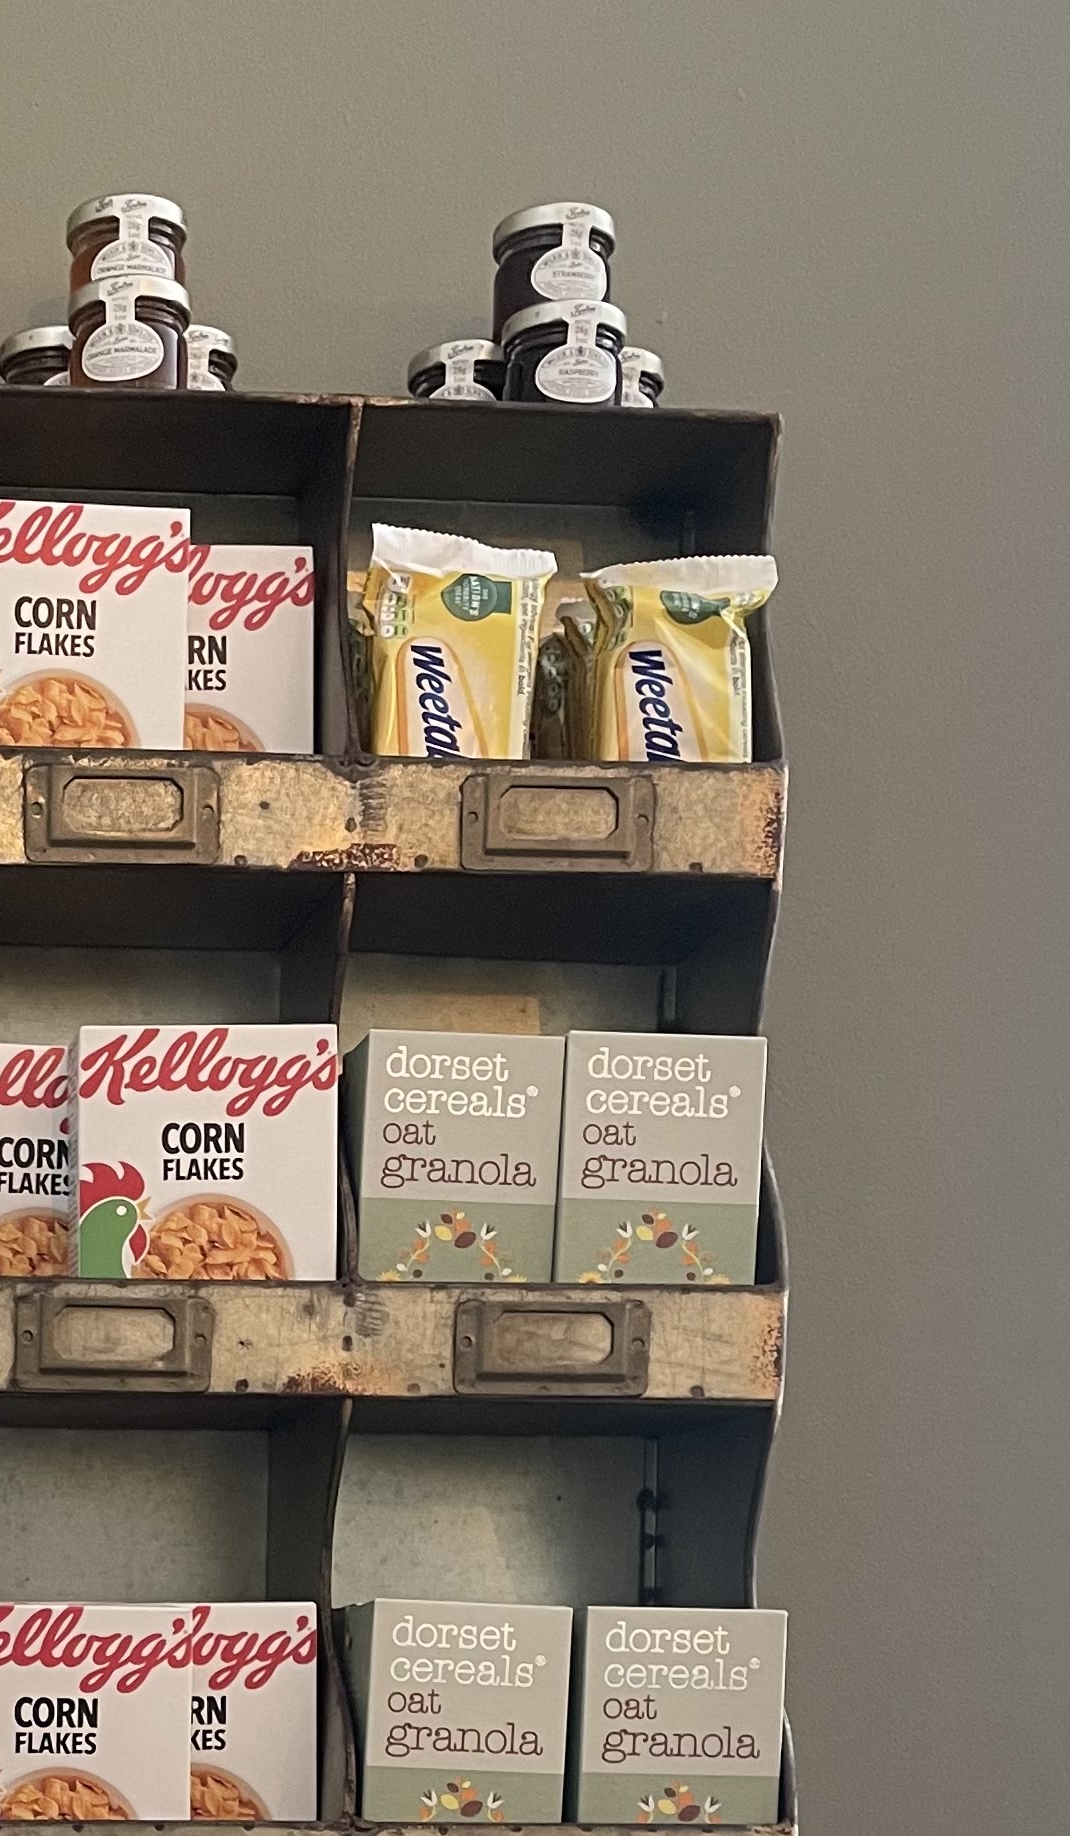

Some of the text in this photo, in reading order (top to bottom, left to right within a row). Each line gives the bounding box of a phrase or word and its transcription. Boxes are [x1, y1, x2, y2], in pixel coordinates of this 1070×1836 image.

[14, 596, 97, 631] CORN
[14, 632, 95, 658] FLAKES
[187, 635, 227, 665] RN
[186, 669, 227, 691] KES
[410, 645, 467, 759] Weeta
[628, 650, 687, 762] Weeta
[79, 1027, 338, 1117] Kellogg's
[386, 1045, 510, 1081] dorset
[587, 1047, 712, 1082] dorset
[161, 1122, 245, 1155] CORN
[382, 1120, 436, 1146] oat
[582, 1121, 637, 1146] oat
[162, 1157, 244, 1181] FLAKES
[380, 1153, 536, 1189] granola
[580, 1154, 738, 1190] granola
[392, 1615, 517, 1652] dorset
[605, 1620, 730, 1654] dorset
[14, 1696, 99, 1728] CORN
[191, 1695, 227, 1725] RN
[387, 1688, 442, 1715] oat
[602, 1694, 658, 1720] oat
[14, 1731, 97, 1755] FLAKES
[191, 1729, 226, 1751] KES
[385, 1722, 544, 1758] granola
[601, 1726, 761, 1764] granola
